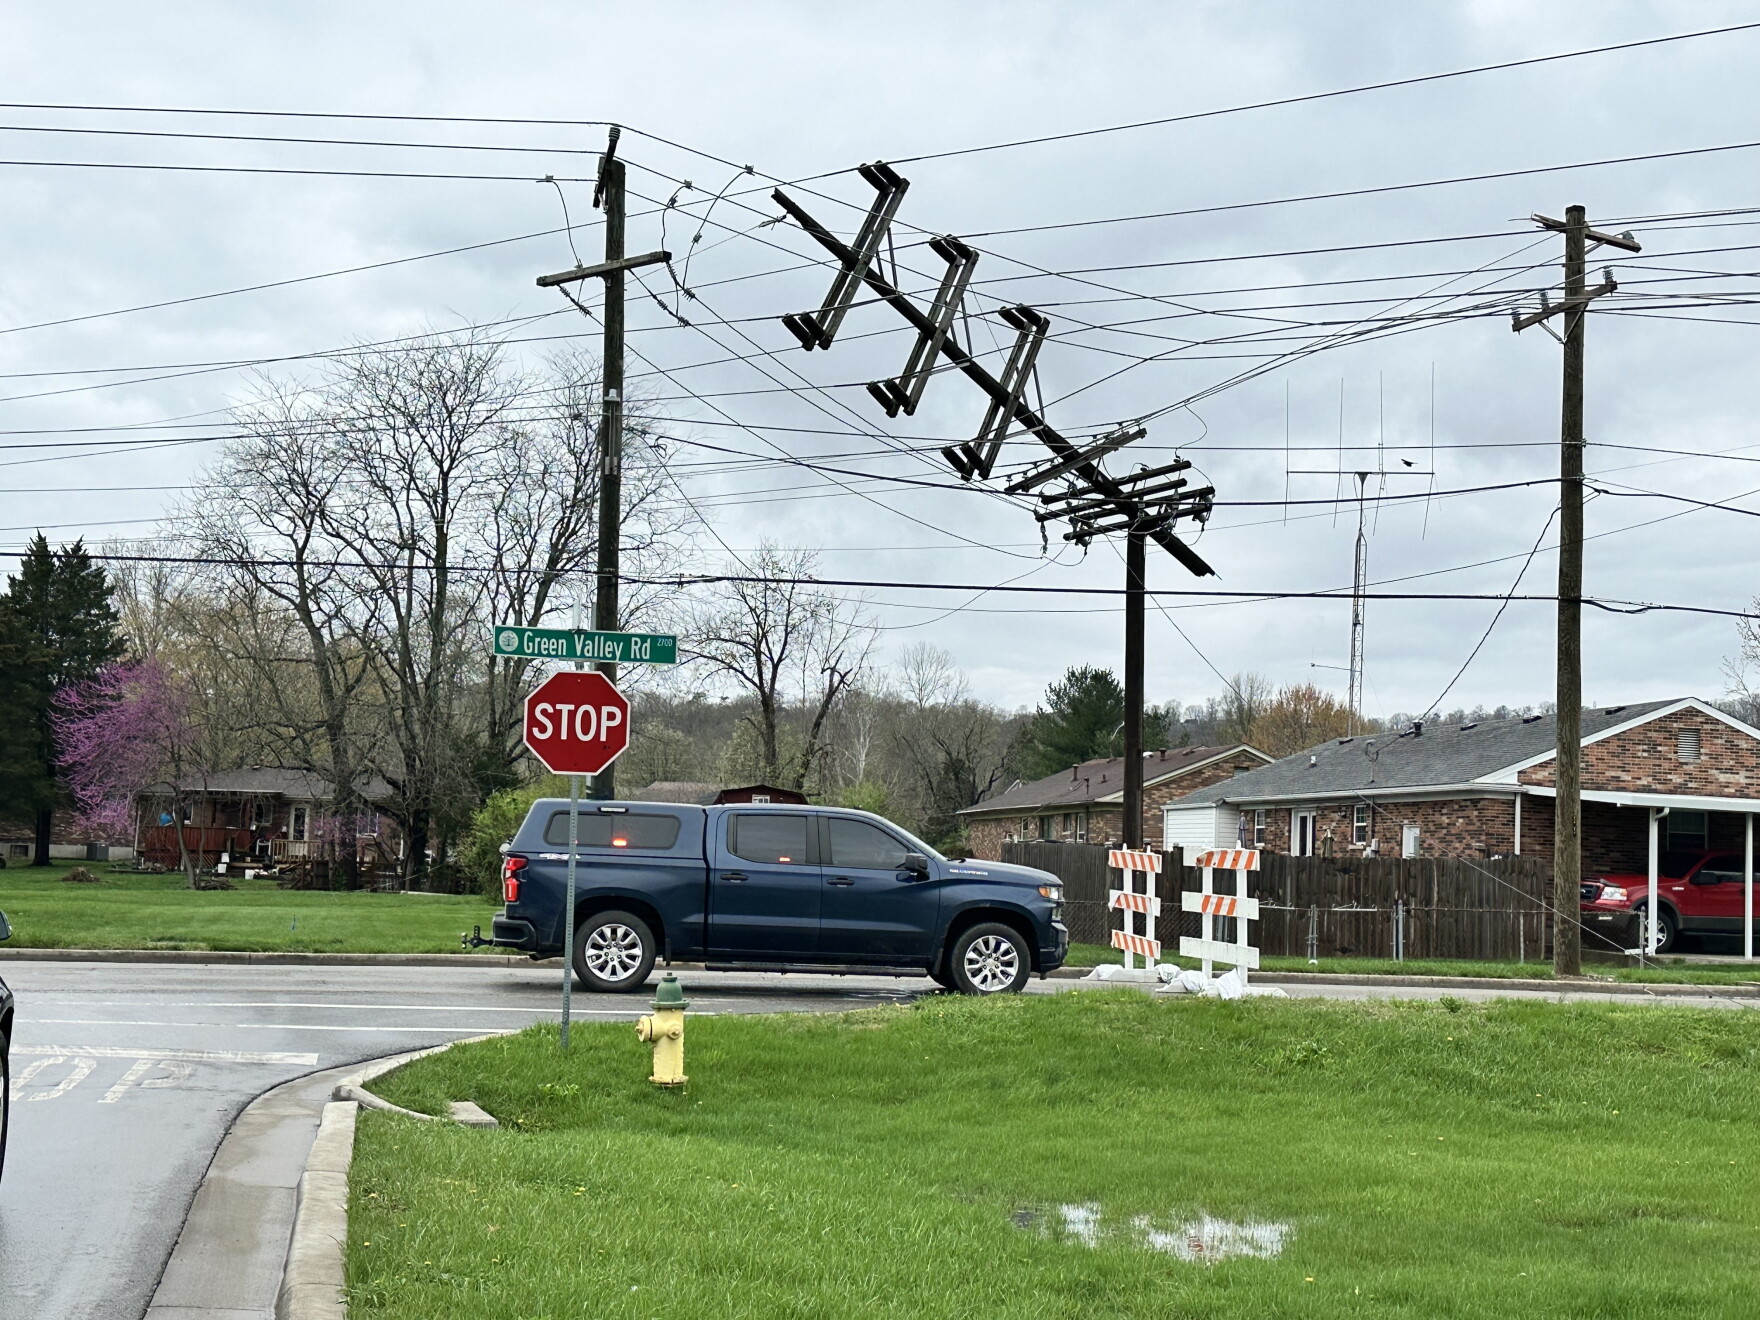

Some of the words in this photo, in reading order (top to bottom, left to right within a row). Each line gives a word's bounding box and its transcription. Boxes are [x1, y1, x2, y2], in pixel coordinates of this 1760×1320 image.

[523, 631, 567, 656] Green
[574, 634, 624, 661] Valley
[630, 636, 651, 660] Rd
[656, 637, 673, 647] 2700
[532, 702, 622, 742] STOP
[9, 1056, 194, 1104] OP
